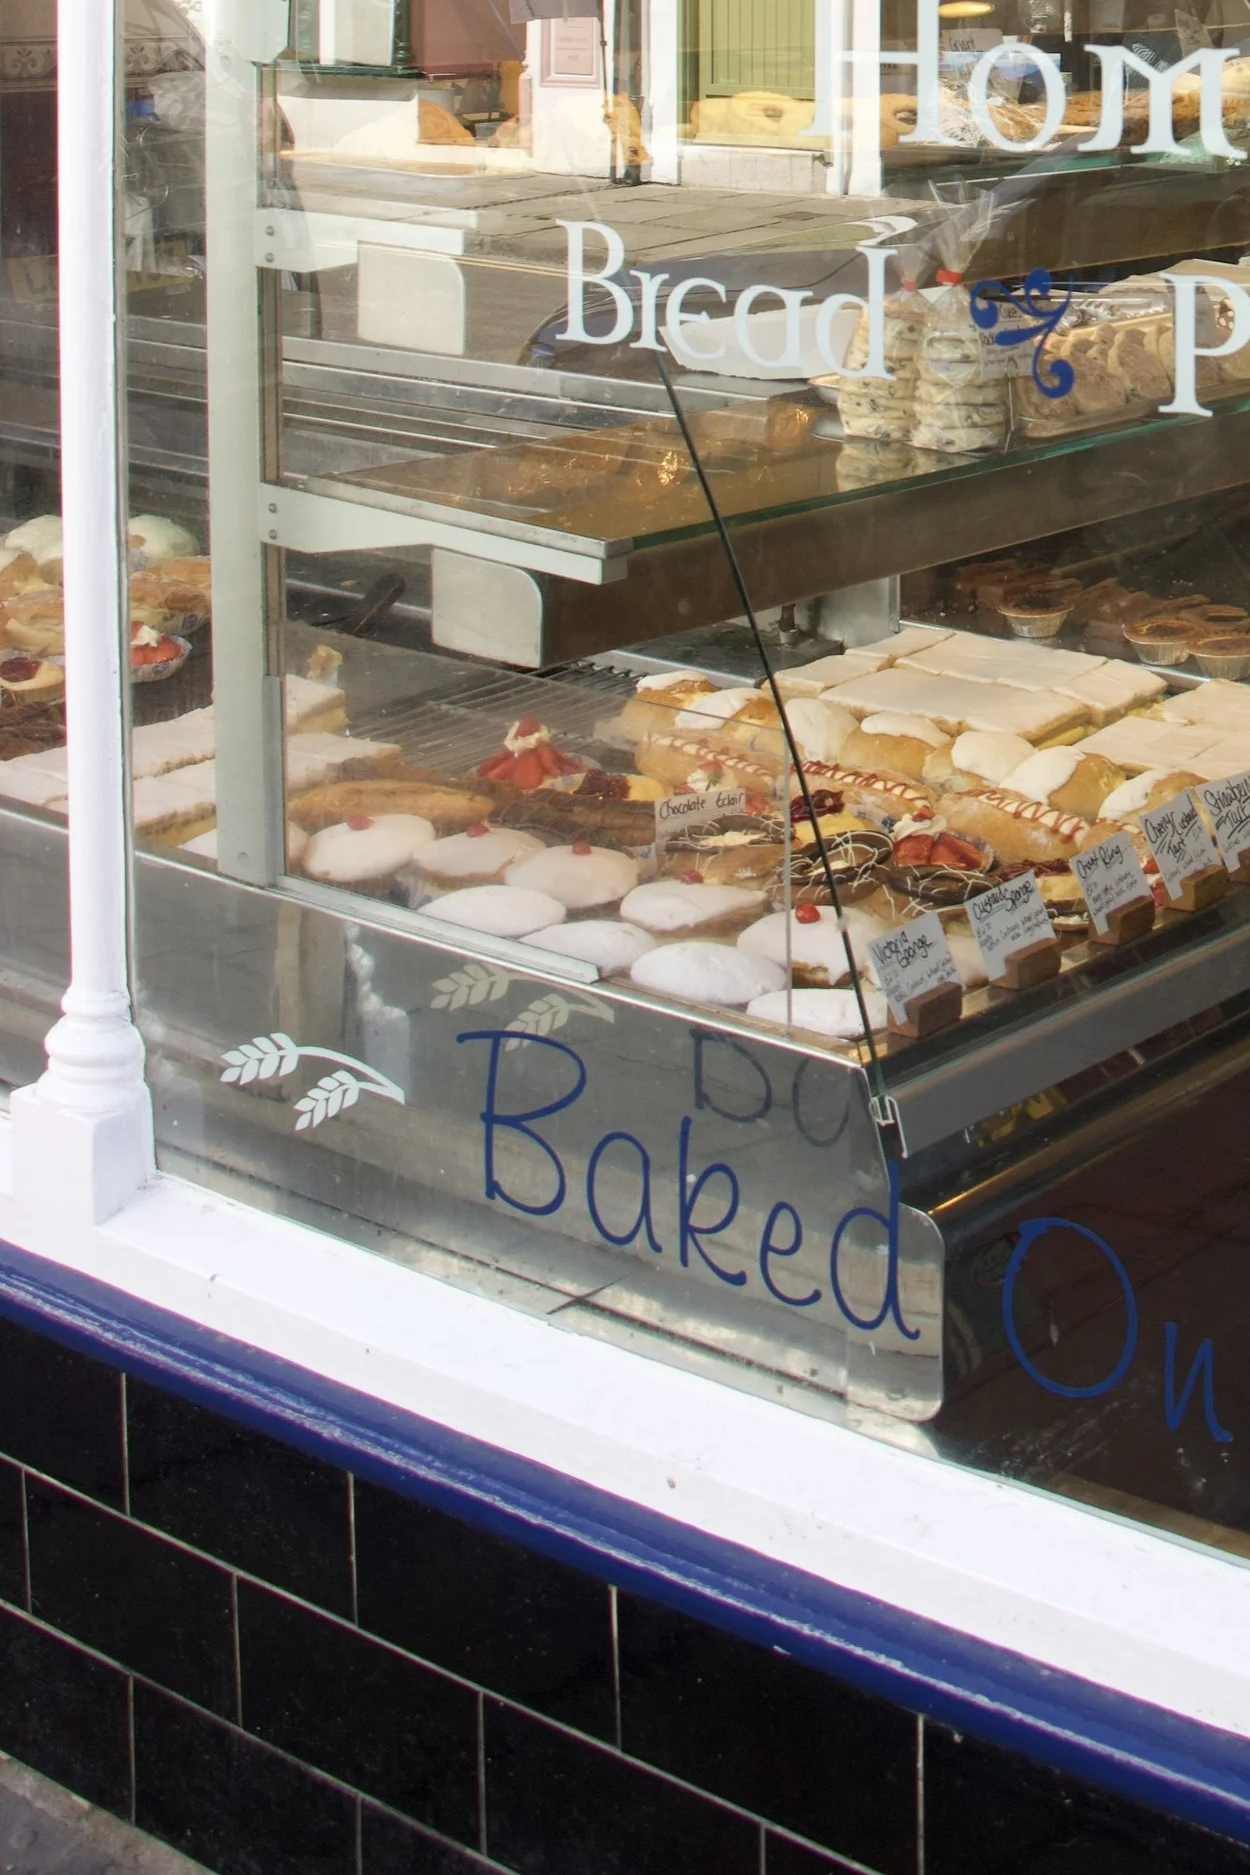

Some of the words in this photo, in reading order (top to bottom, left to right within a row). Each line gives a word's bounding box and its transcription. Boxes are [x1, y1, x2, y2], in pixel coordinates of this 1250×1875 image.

[555, 215, 917, 382] Bread
[658, 796, 706, 820] Chocolate
[456, 1028, 922, 1340] Baked
[1003, 1217, 1233, 1443] On
